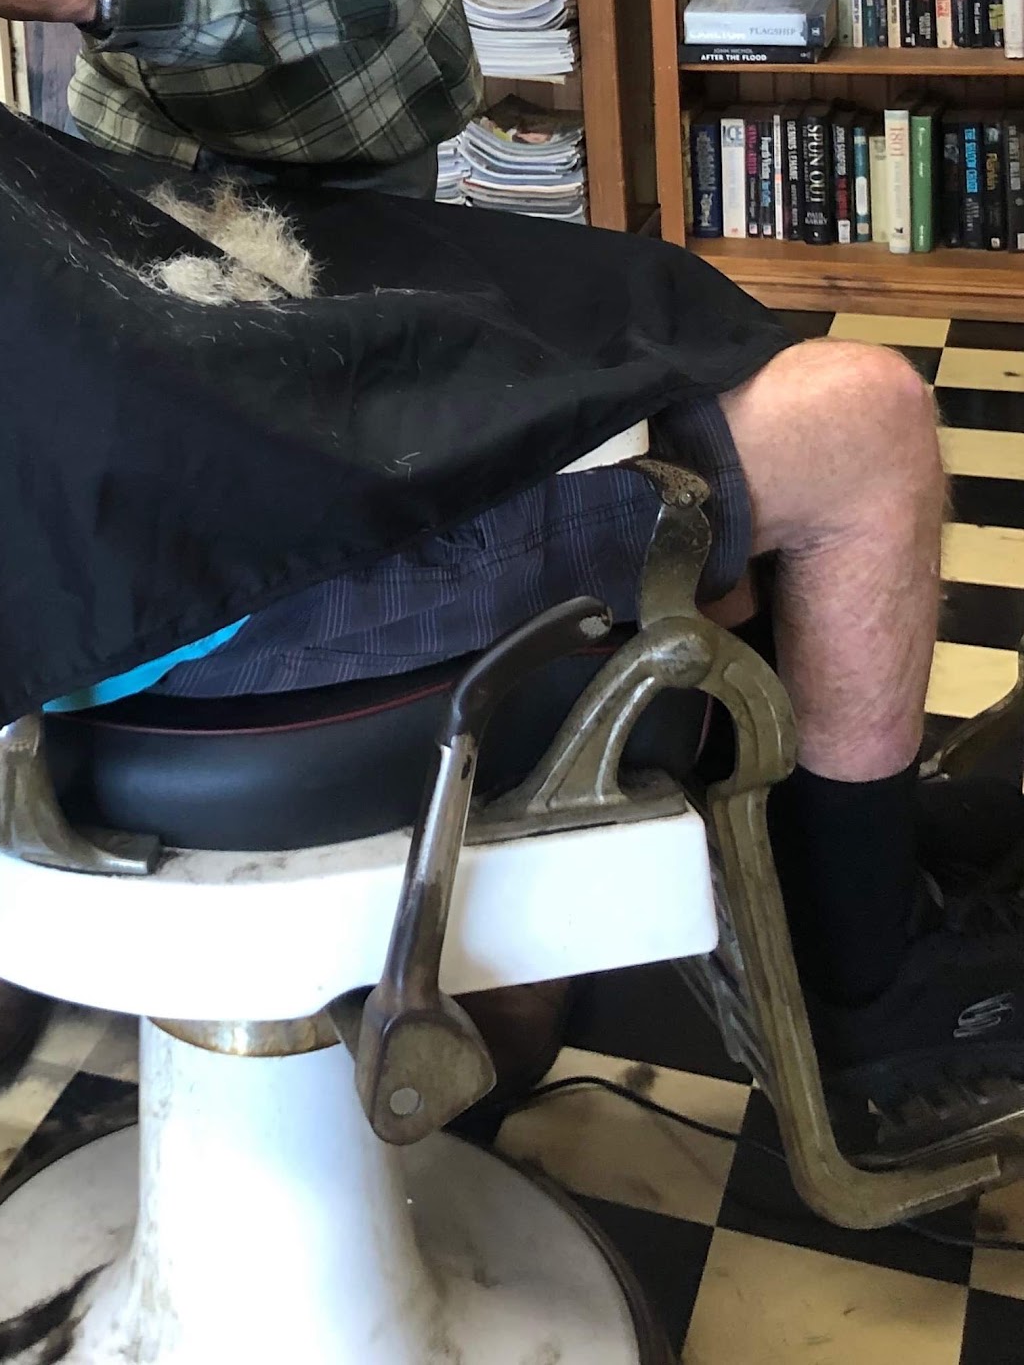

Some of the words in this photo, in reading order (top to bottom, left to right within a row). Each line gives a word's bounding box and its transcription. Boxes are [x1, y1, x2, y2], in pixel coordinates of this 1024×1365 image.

[749, 27, 797, 36] FLAGSHIP
[701, 54, 724, 62] AFTER
[726, 54, 741, 62] THE
[743, 54, 767, 62] FLOOD
[786, 121, 797, 150] DENNIS
[807, 124, 824, 166] SPUN
[836, 125, 845, 143] JOHN
[890, 127, 905, 157] 1801
[788, 150, 798, 181] LEHANE
[837, 144, 846, 175] SANDFORD
[986, 153, 998, 191] Rankin
[809, 170, 825, 203] OUT
